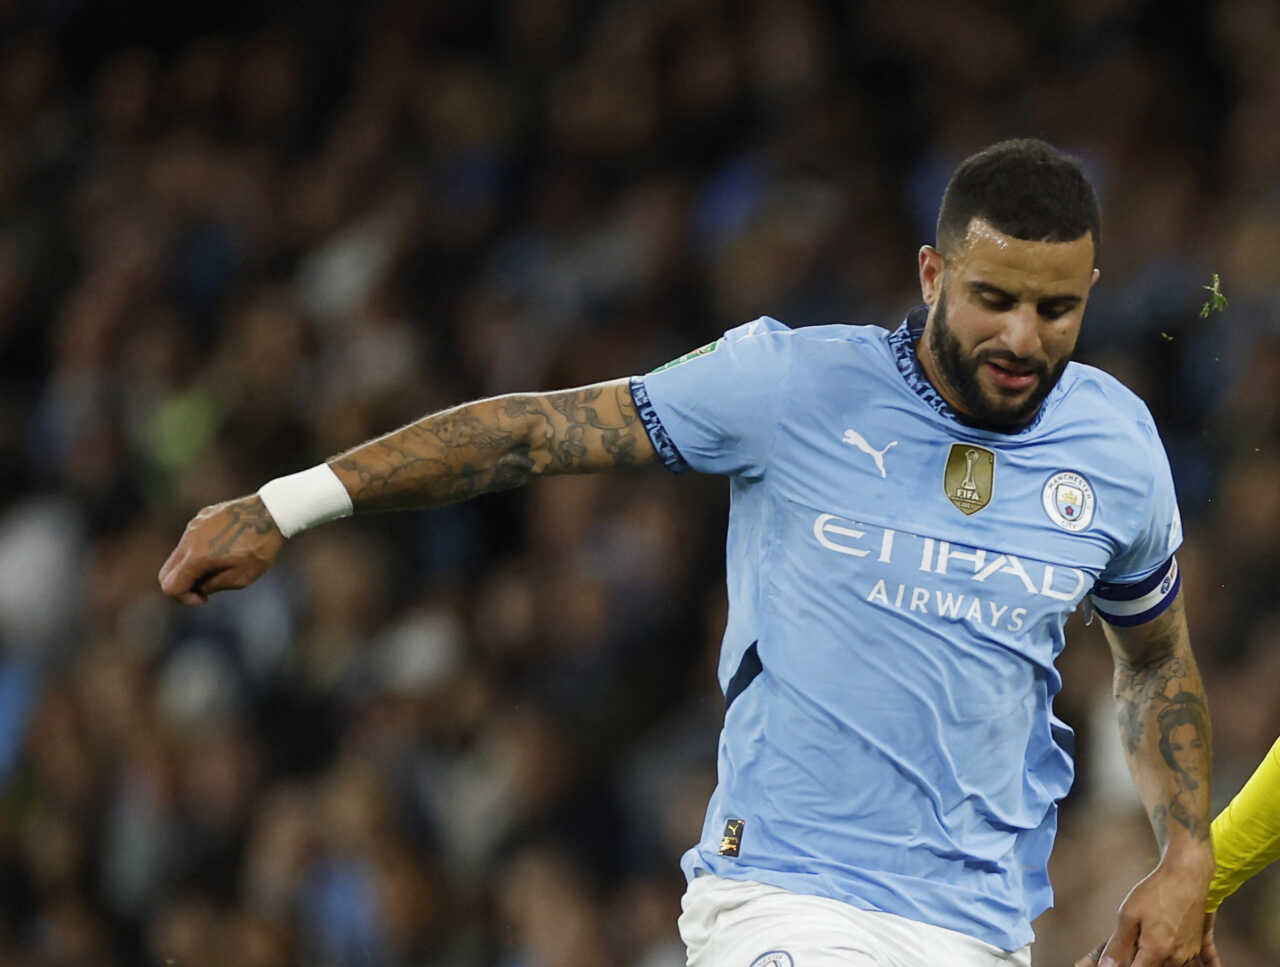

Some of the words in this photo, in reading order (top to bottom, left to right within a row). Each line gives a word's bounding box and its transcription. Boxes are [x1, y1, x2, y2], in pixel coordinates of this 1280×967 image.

[956, 488, 980, 500] FIFA
[813, 513, 1085, 601] ETIHAD
[867, 578, 1028, 632] AIRWAYS
